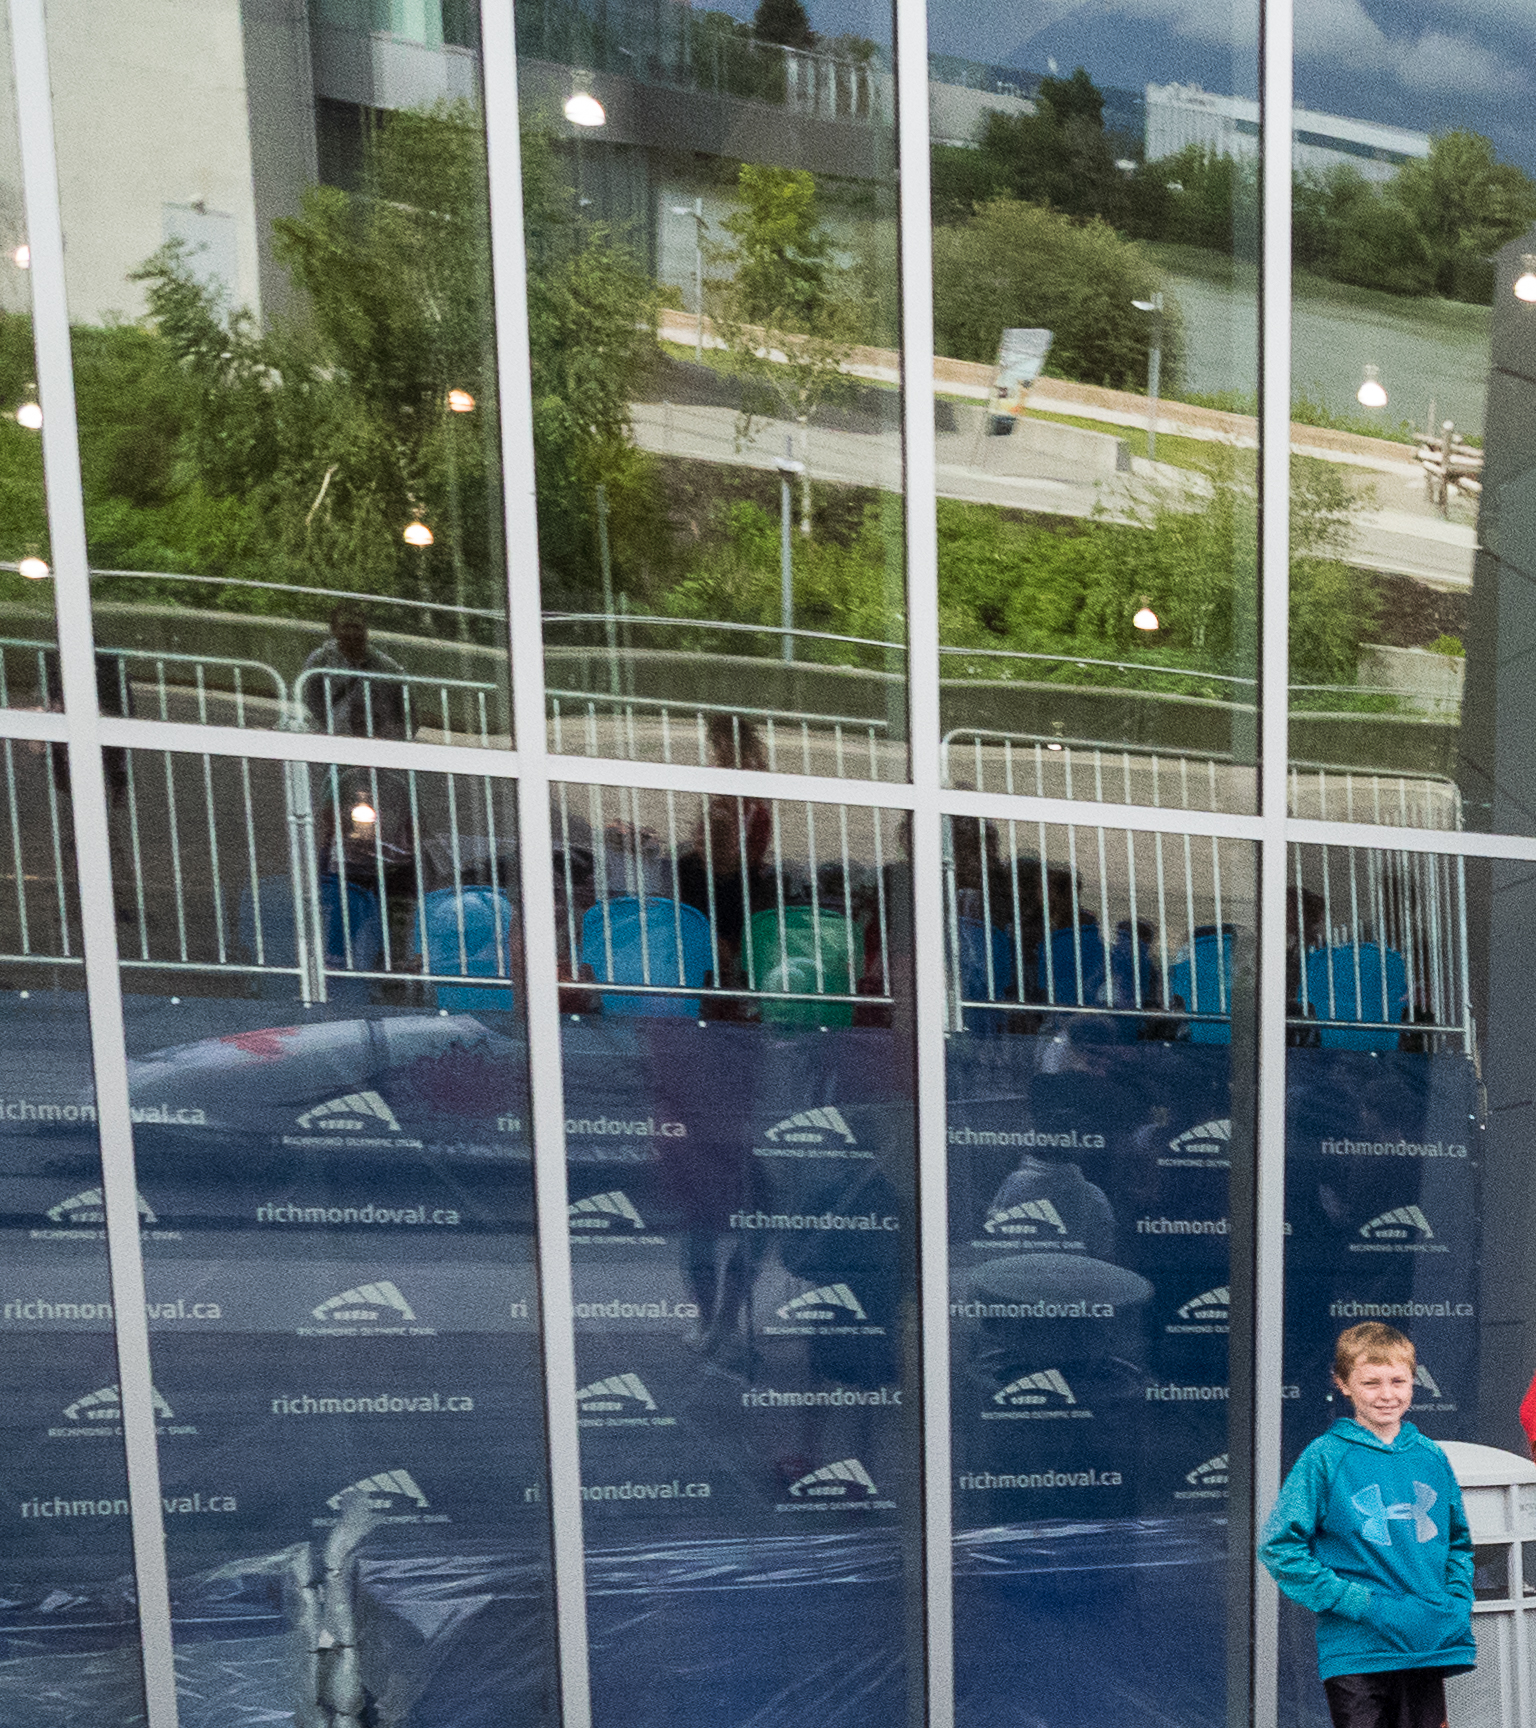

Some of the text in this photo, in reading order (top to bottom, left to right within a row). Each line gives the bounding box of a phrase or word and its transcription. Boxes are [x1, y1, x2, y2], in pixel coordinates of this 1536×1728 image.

[947, 1127, 1106, 1149] ichmondoval.ca
[1321, 1137, 1467, 1157] richmondoval.ca
[256, 1203, 460, 1225] richmondoval.ca
[730, 1211, 900, 1231] richmondoval.c
[1330, 1300, 1474, 1317] richmondoval.ca
[271, 1393, 474, 1415] richmondoval.ca
[742, 1387, 902, 1407] richmondoval.c
[959, 1469, 1122, 1490] richmondoval.ca
